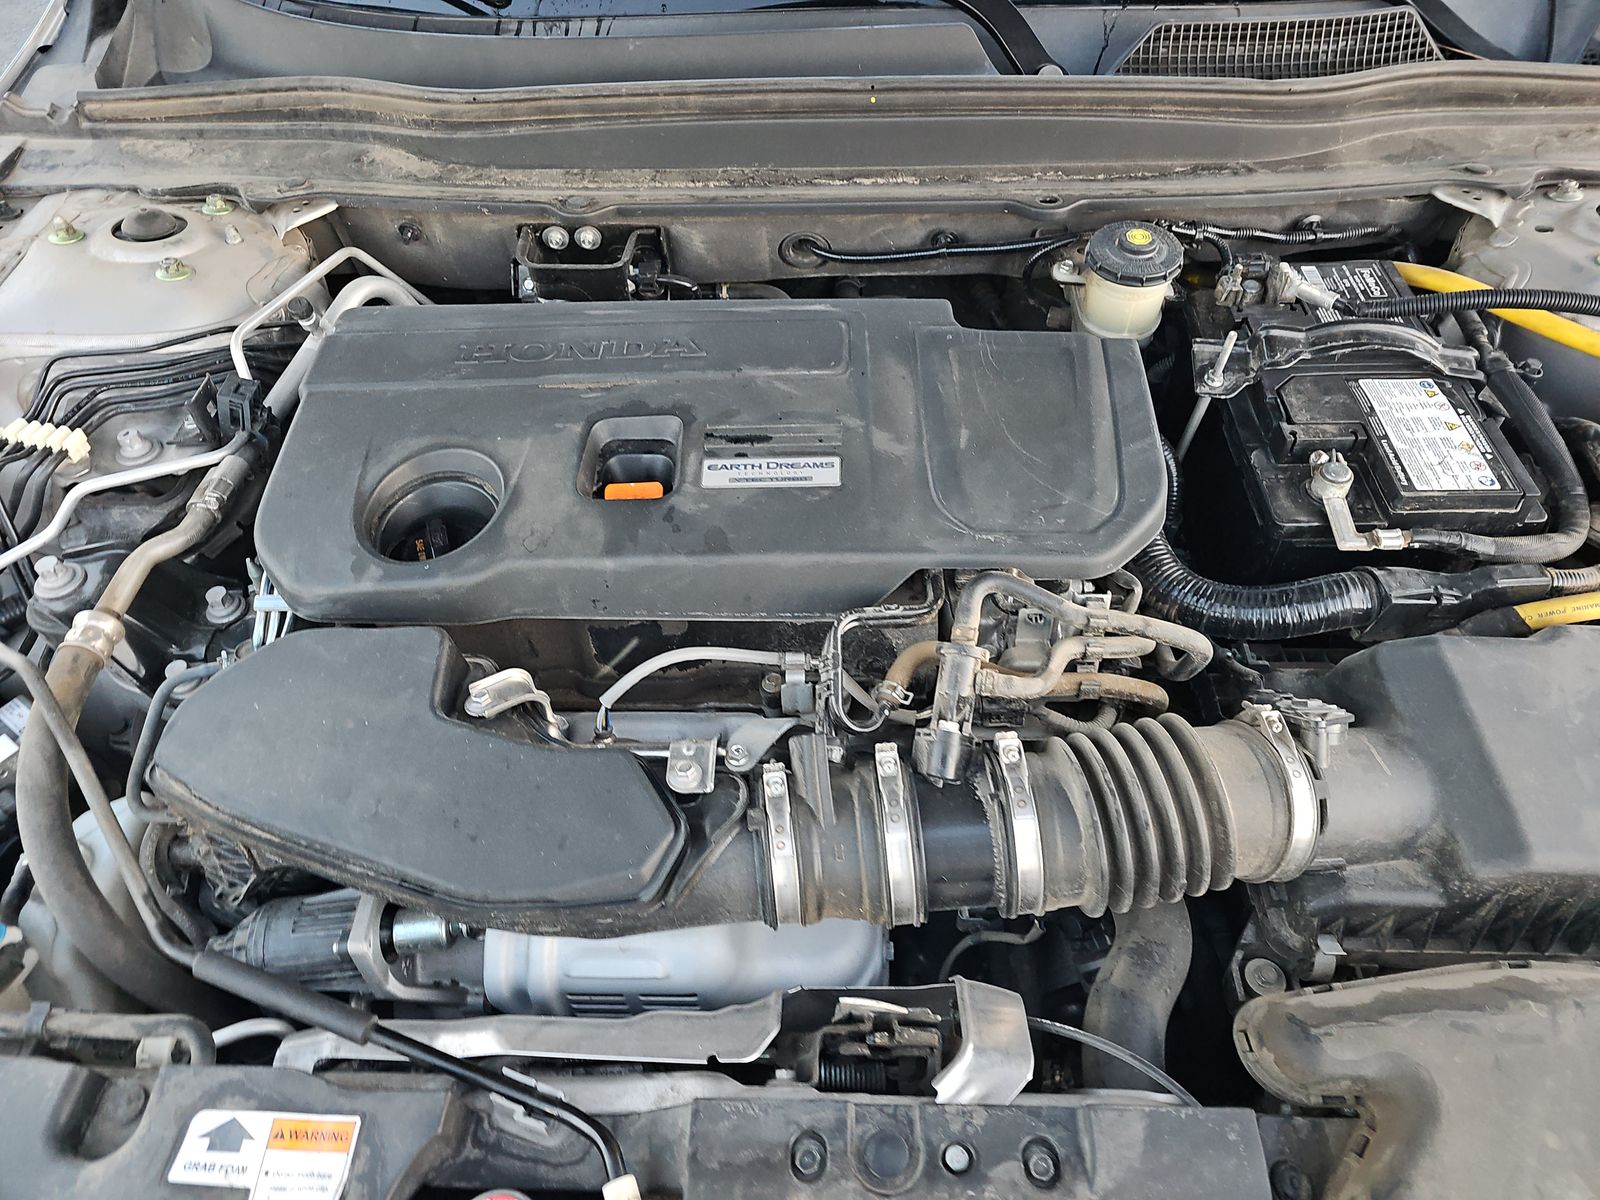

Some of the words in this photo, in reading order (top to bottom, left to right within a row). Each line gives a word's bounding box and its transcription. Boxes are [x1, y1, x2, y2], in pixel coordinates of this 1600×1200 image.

[454, 338, 707, 365] HONDA
[707, 463, 762, 471] EARTH
[767, 462, 835, 470] DREAMS
[1537, 608, 1566, 618] POWER
[289, 1128, 348, 1143] WARNING
[183, 1160, 216, 1173] GRAB
